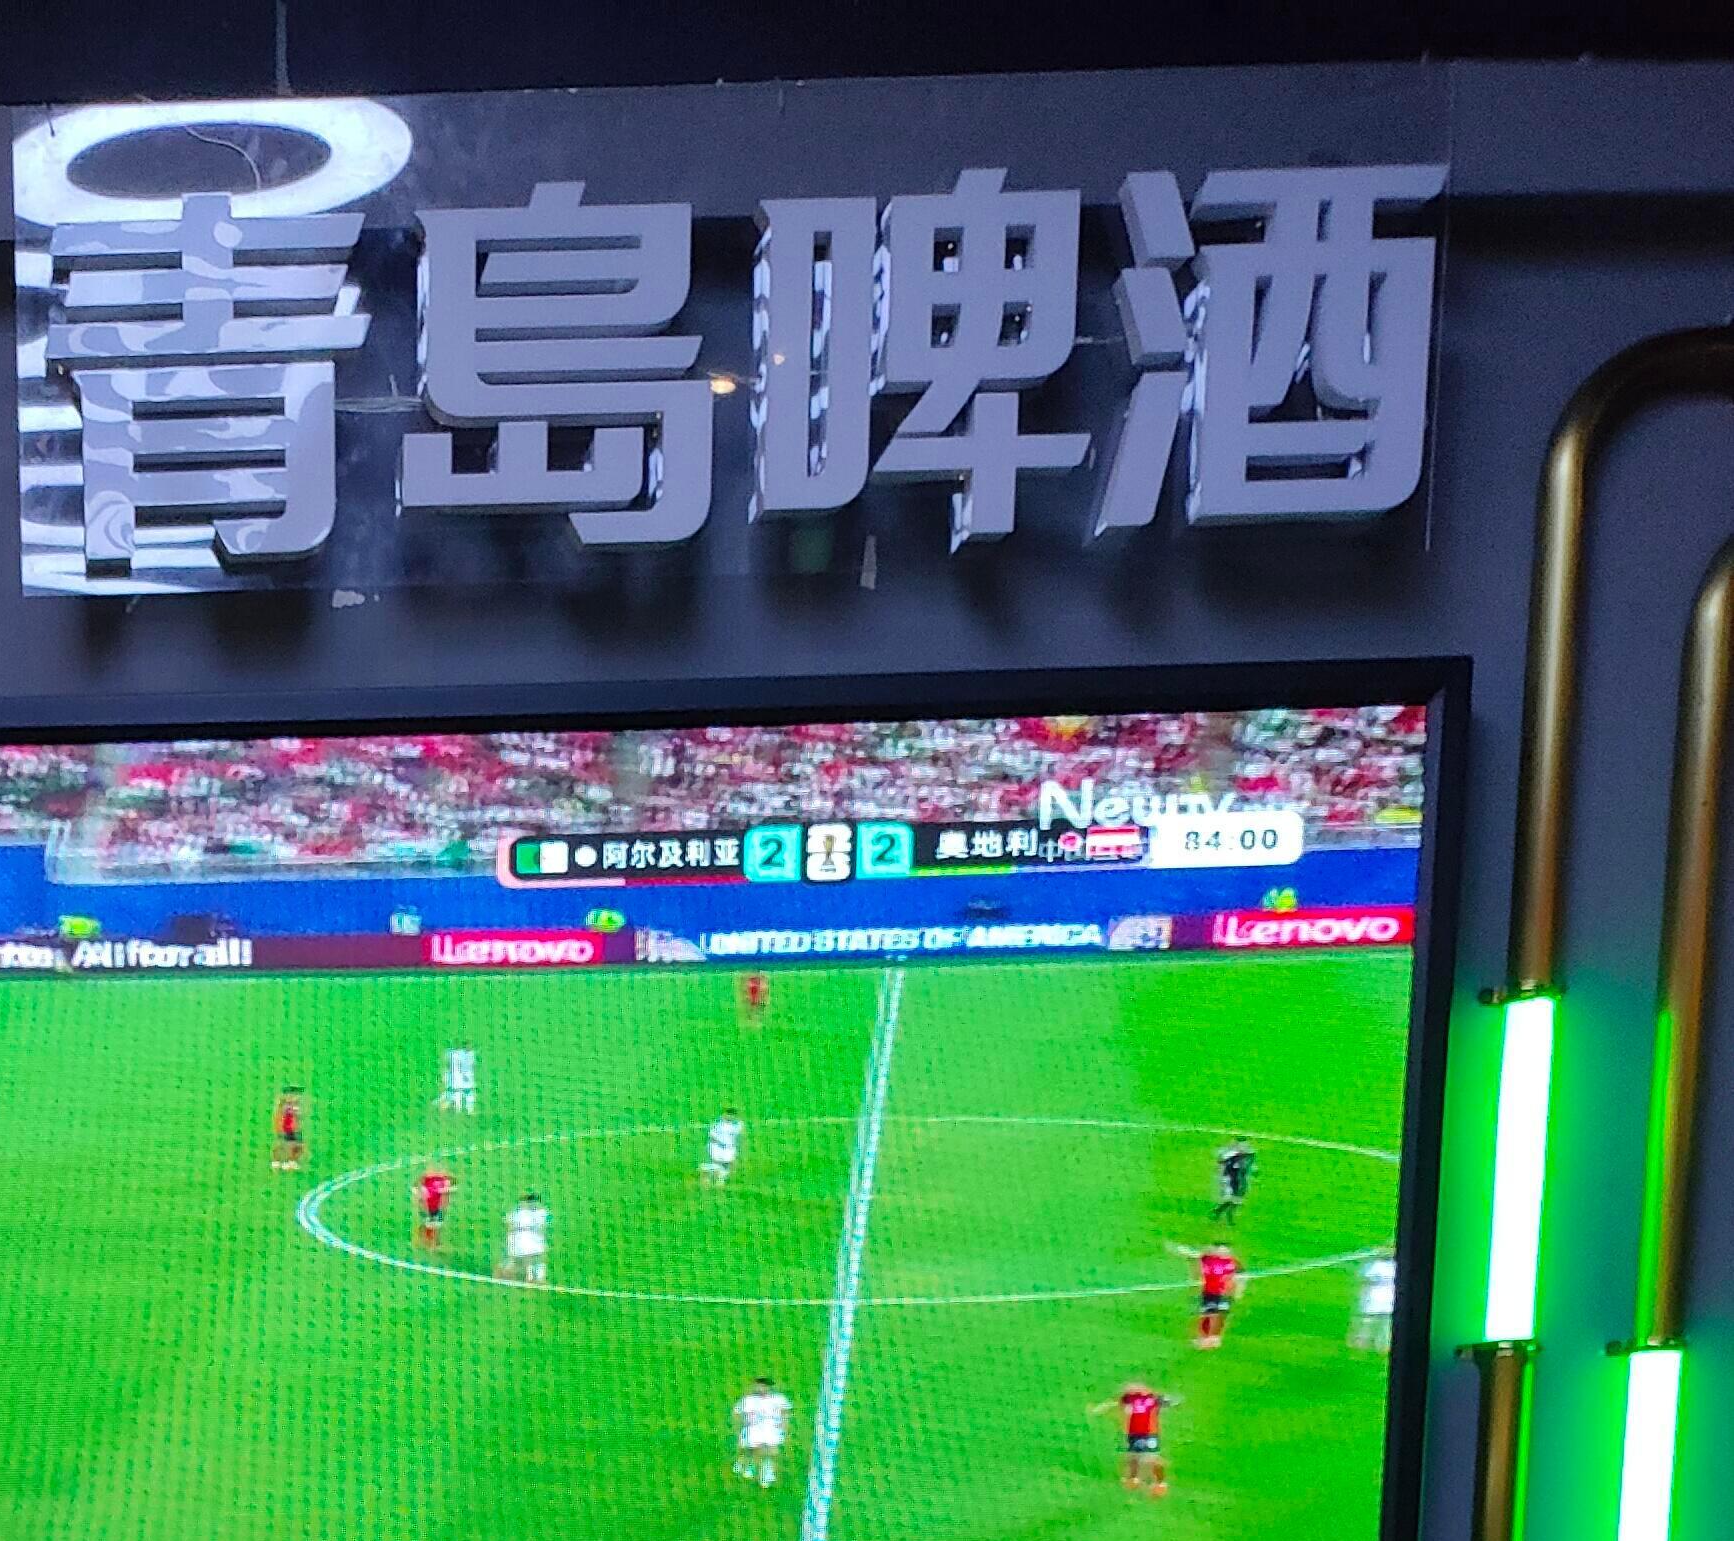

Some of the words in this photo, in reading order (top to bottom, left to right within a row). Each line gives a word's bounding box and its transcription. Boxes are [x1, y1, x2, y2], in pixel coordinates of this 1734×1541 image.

[602, 838, 740, 868] 阿尔及利亚
[760, 838, 785, 868] 2
[872, 834, 896, 866] 2
[935, 829, 1038, 860] 奥地利
[1184, 829, 1279, 851] 84:00
[1214, 913, 1401, 945] Lenovo
[432, 936, 595, 965] Lenovo
